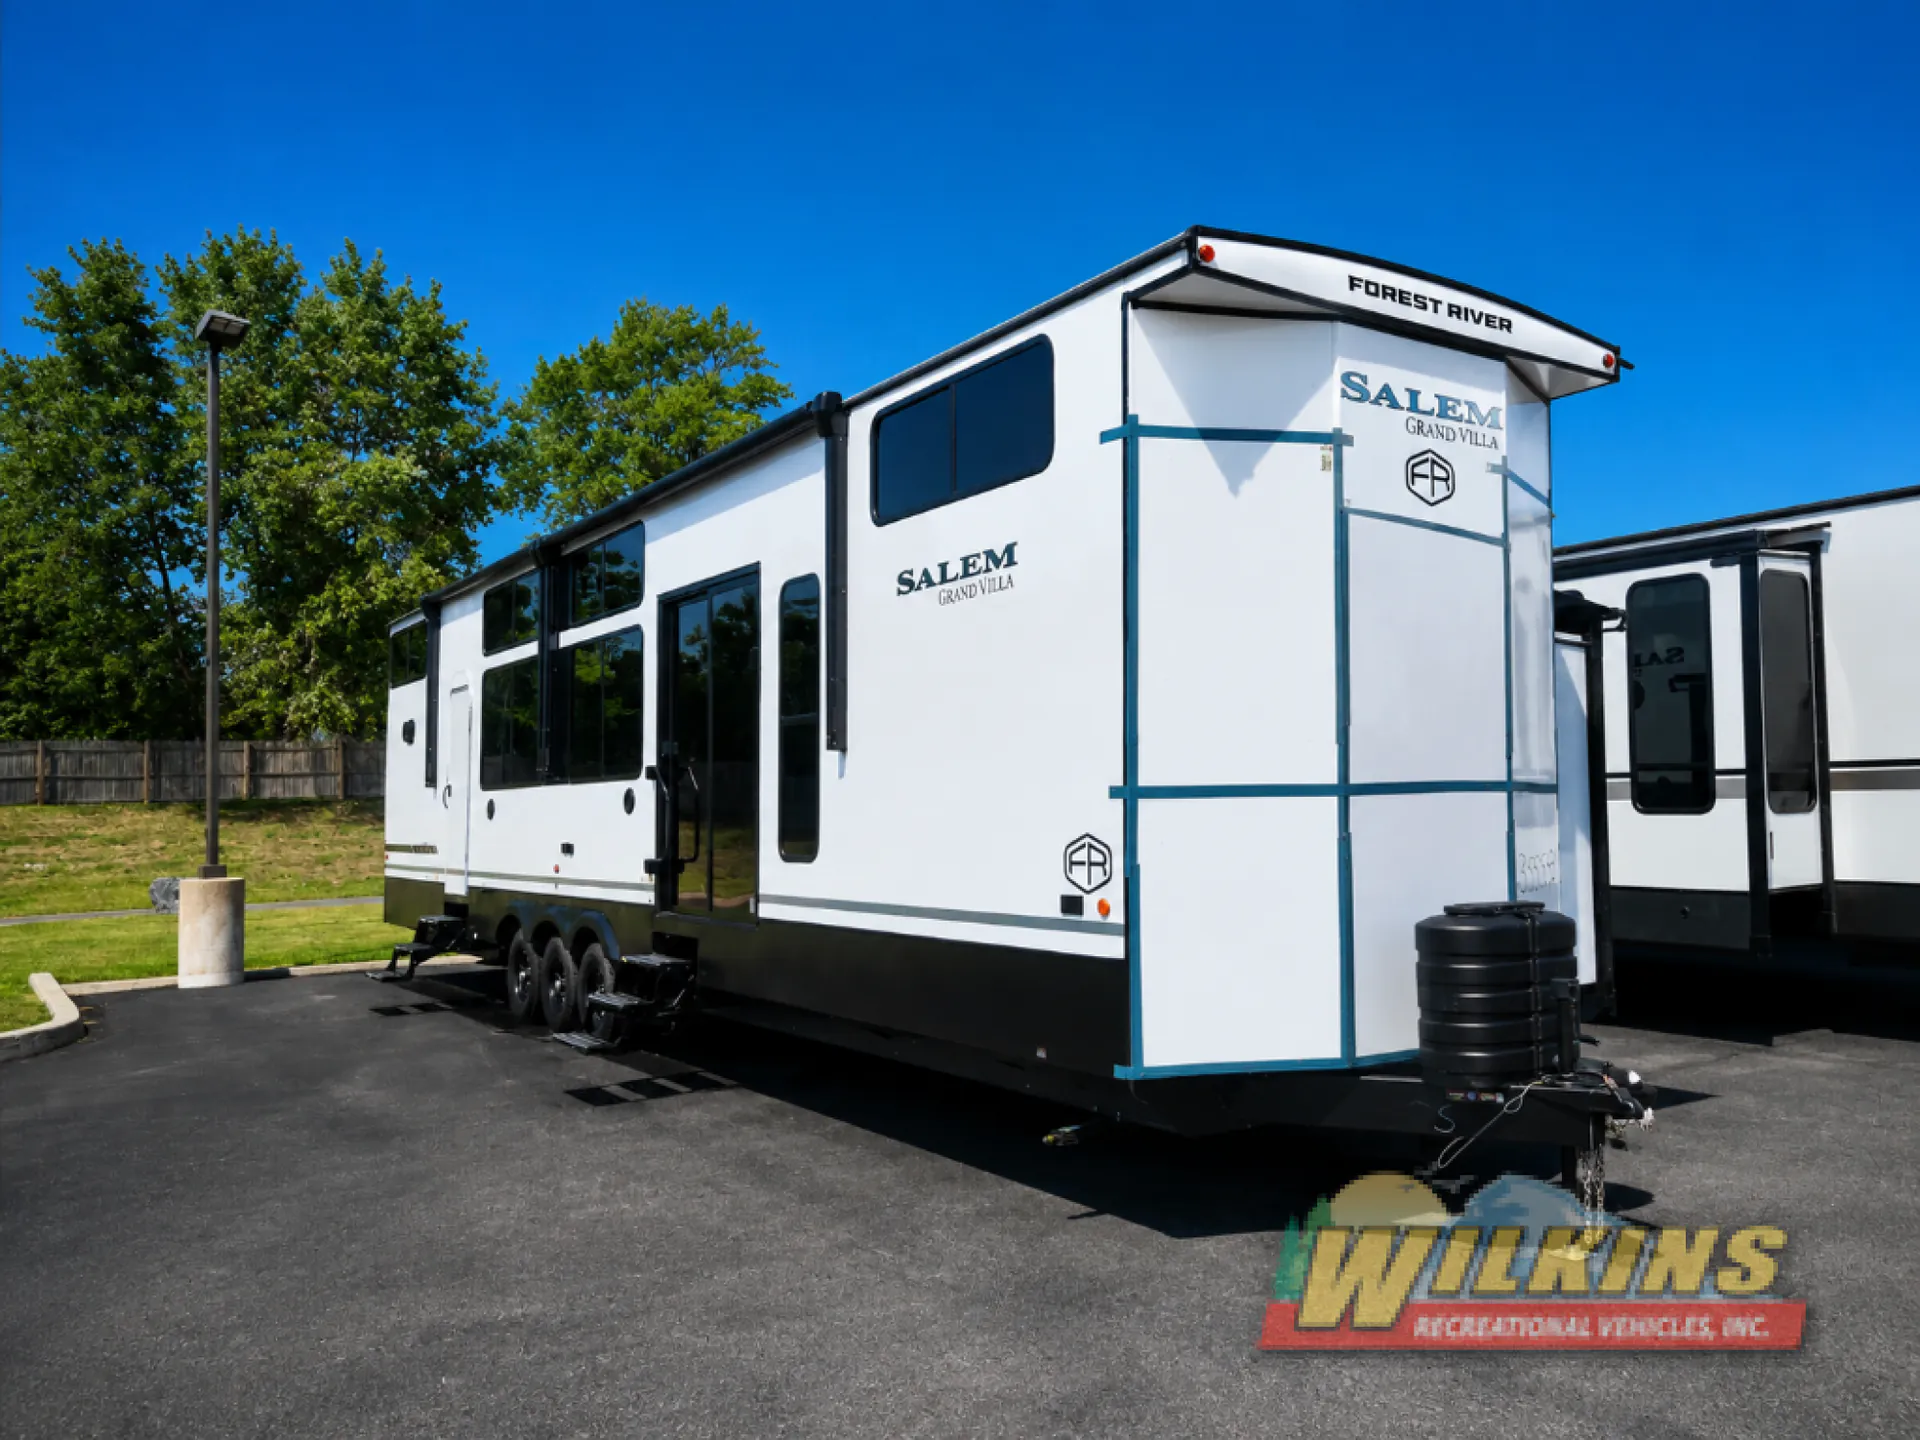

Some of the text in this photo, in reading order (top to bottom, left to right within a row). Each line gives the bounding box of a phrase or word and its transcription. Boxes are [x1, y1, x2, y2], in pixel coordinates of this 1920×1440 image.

[1348, 275, 1513, 334] FOREST RIVER
[1340, 370, 1503, 430] SALEM
[1405, 416, 1499, 450] GRAND VILLA
[896, 541, 1019, 597] SALEM
[938, 573, 1015, 606] GRAND VILLA
